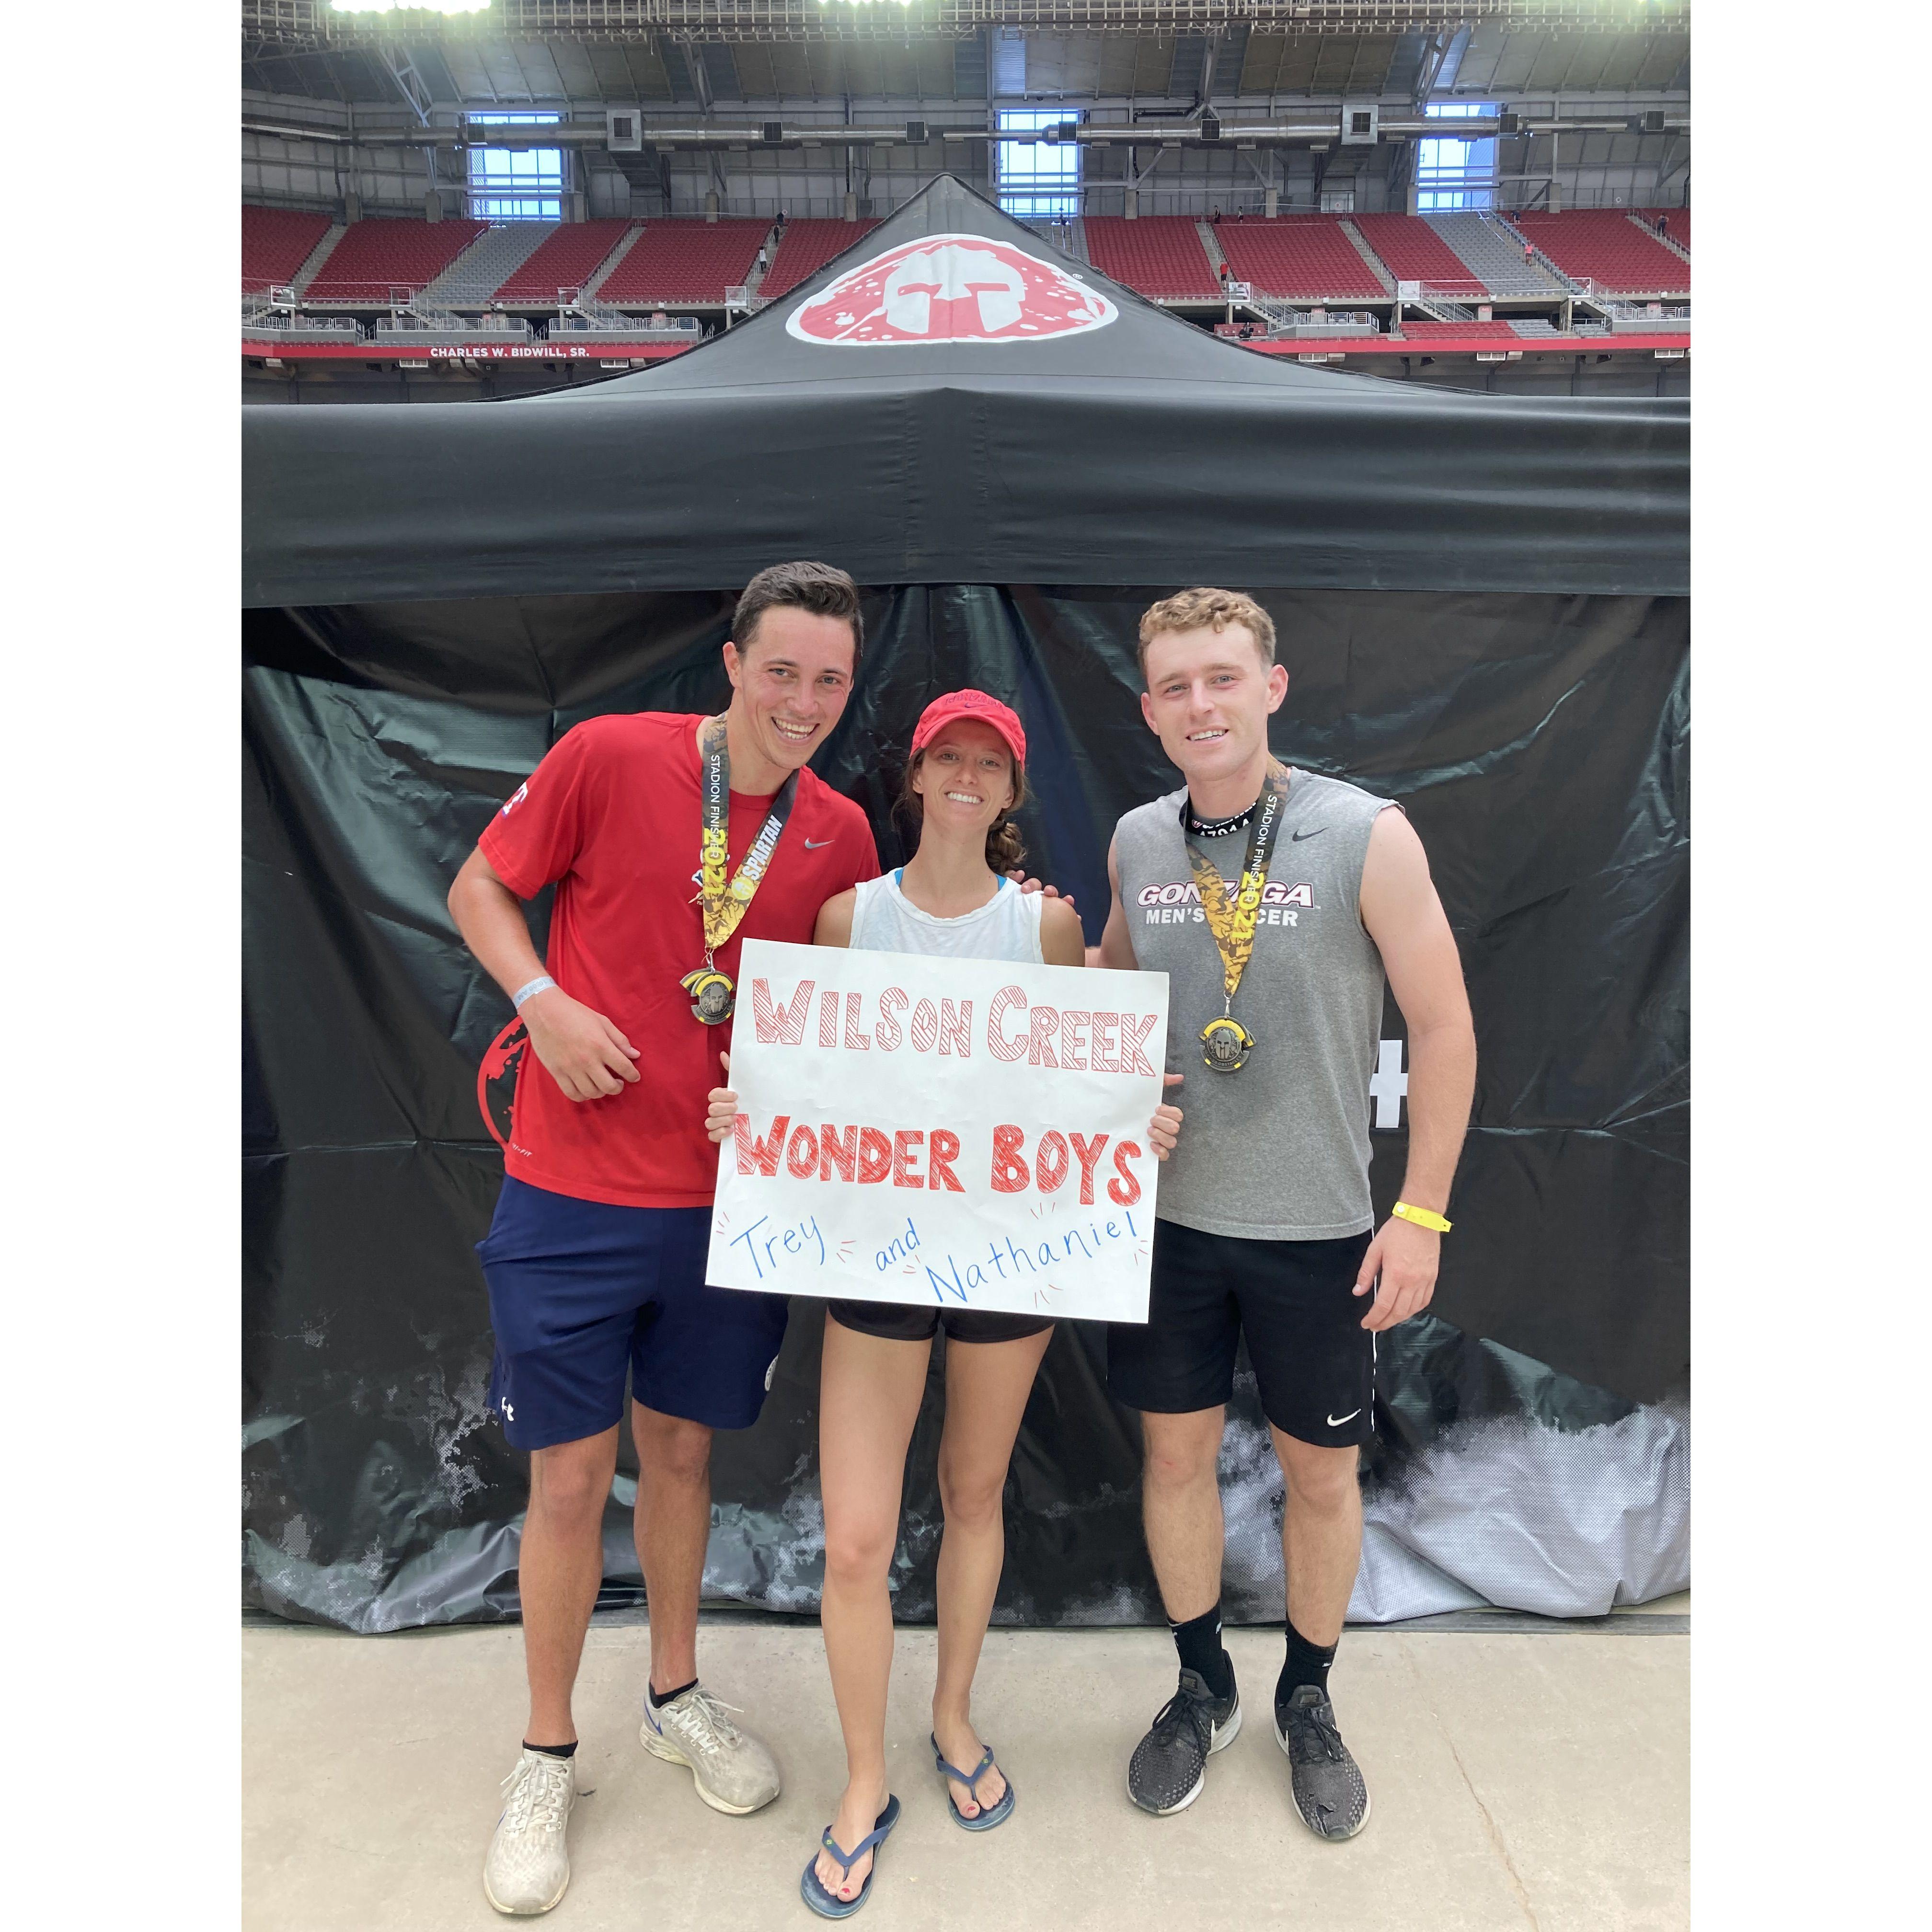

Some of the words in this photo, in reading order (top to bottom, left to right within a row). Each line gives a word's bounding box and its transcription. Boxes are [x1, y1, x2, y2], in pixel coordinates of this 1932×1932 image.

[430, 347, 488, 357] CHARLES
[491, 348, 507, 357] W.
[511, 348, 566, 358] BIDWILL,
[570, 348, 589, 357] SR.
[710, 755, 721, 803] STADION
[742, 815, 783, 881] SPARTAN
[1257, 794, 1278, 845] STADION
[703, 828, 726, 895] 2021
[1136, 881, 1314, 909] GONGA
[1146, 908, 1205, 925] MEN'S
[1231, 872, 1265, 939] 2021
[752, 978, 973, 1058] WILSON
[987, 985, 1158, 1077] CREEK
[735, 1113, 966, 1193] WONDER
[991, 1124, 1142, 1207] BOYS
[730, 1215, 827, 1278] Trey
[875, 1217, 920, 1272] and
[925, 1210, 1138, 1303] Nathaniel
